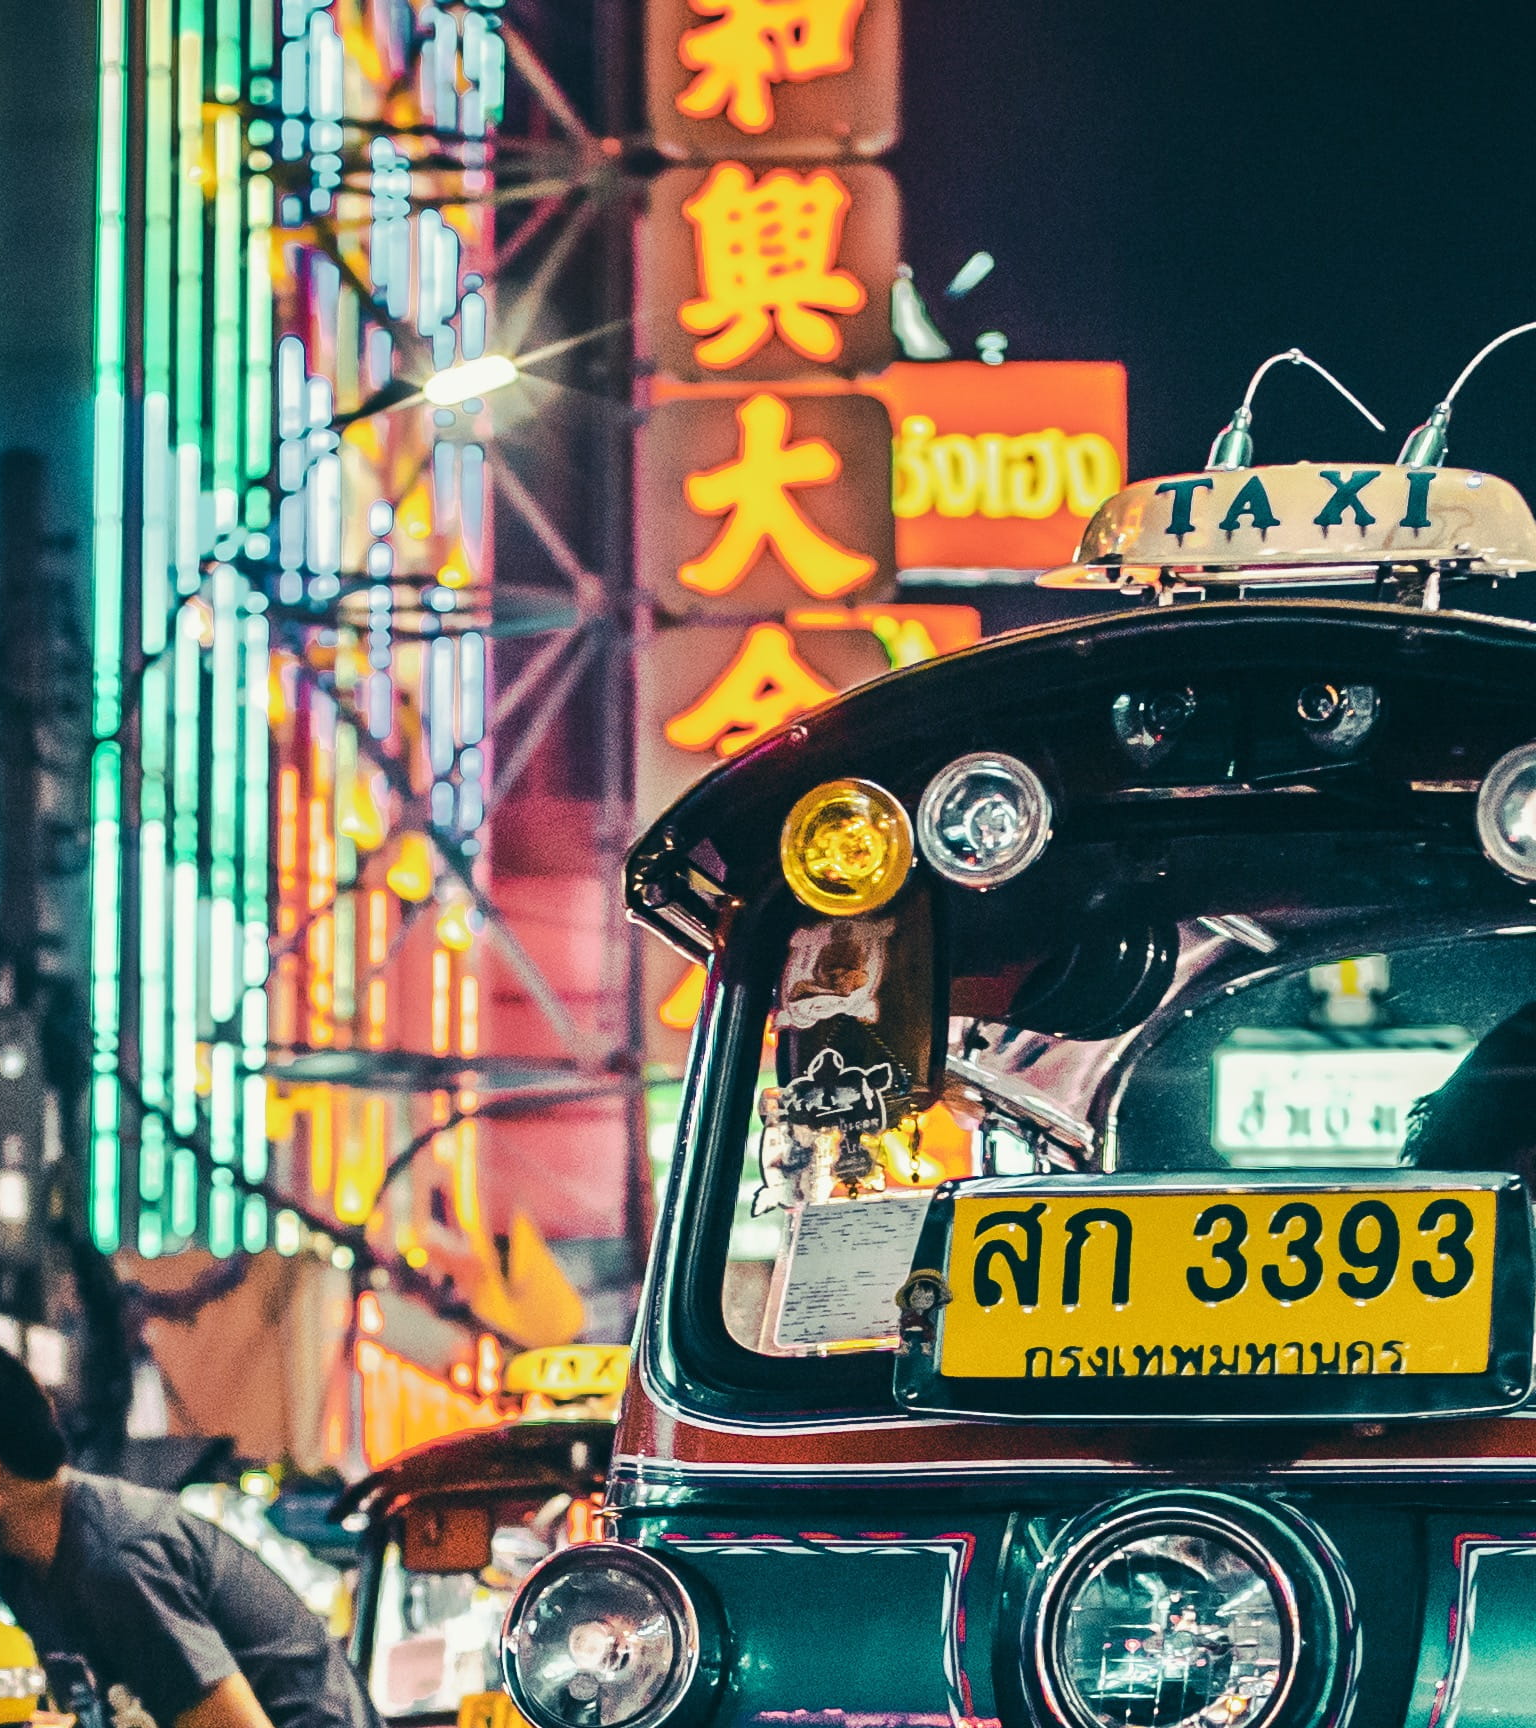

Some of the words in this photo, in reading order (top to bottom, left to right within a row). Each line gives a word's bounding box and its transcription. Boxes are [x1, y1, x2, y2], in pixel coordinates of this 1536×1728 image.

[1155, 470, 1437, 538] TAXI
[972, 1202, 1134, 1307] สก
[1185, 1198, 1475, 1303] 3393
[1023, 1339, 1407, 1377] กรงเทพมหานคร
